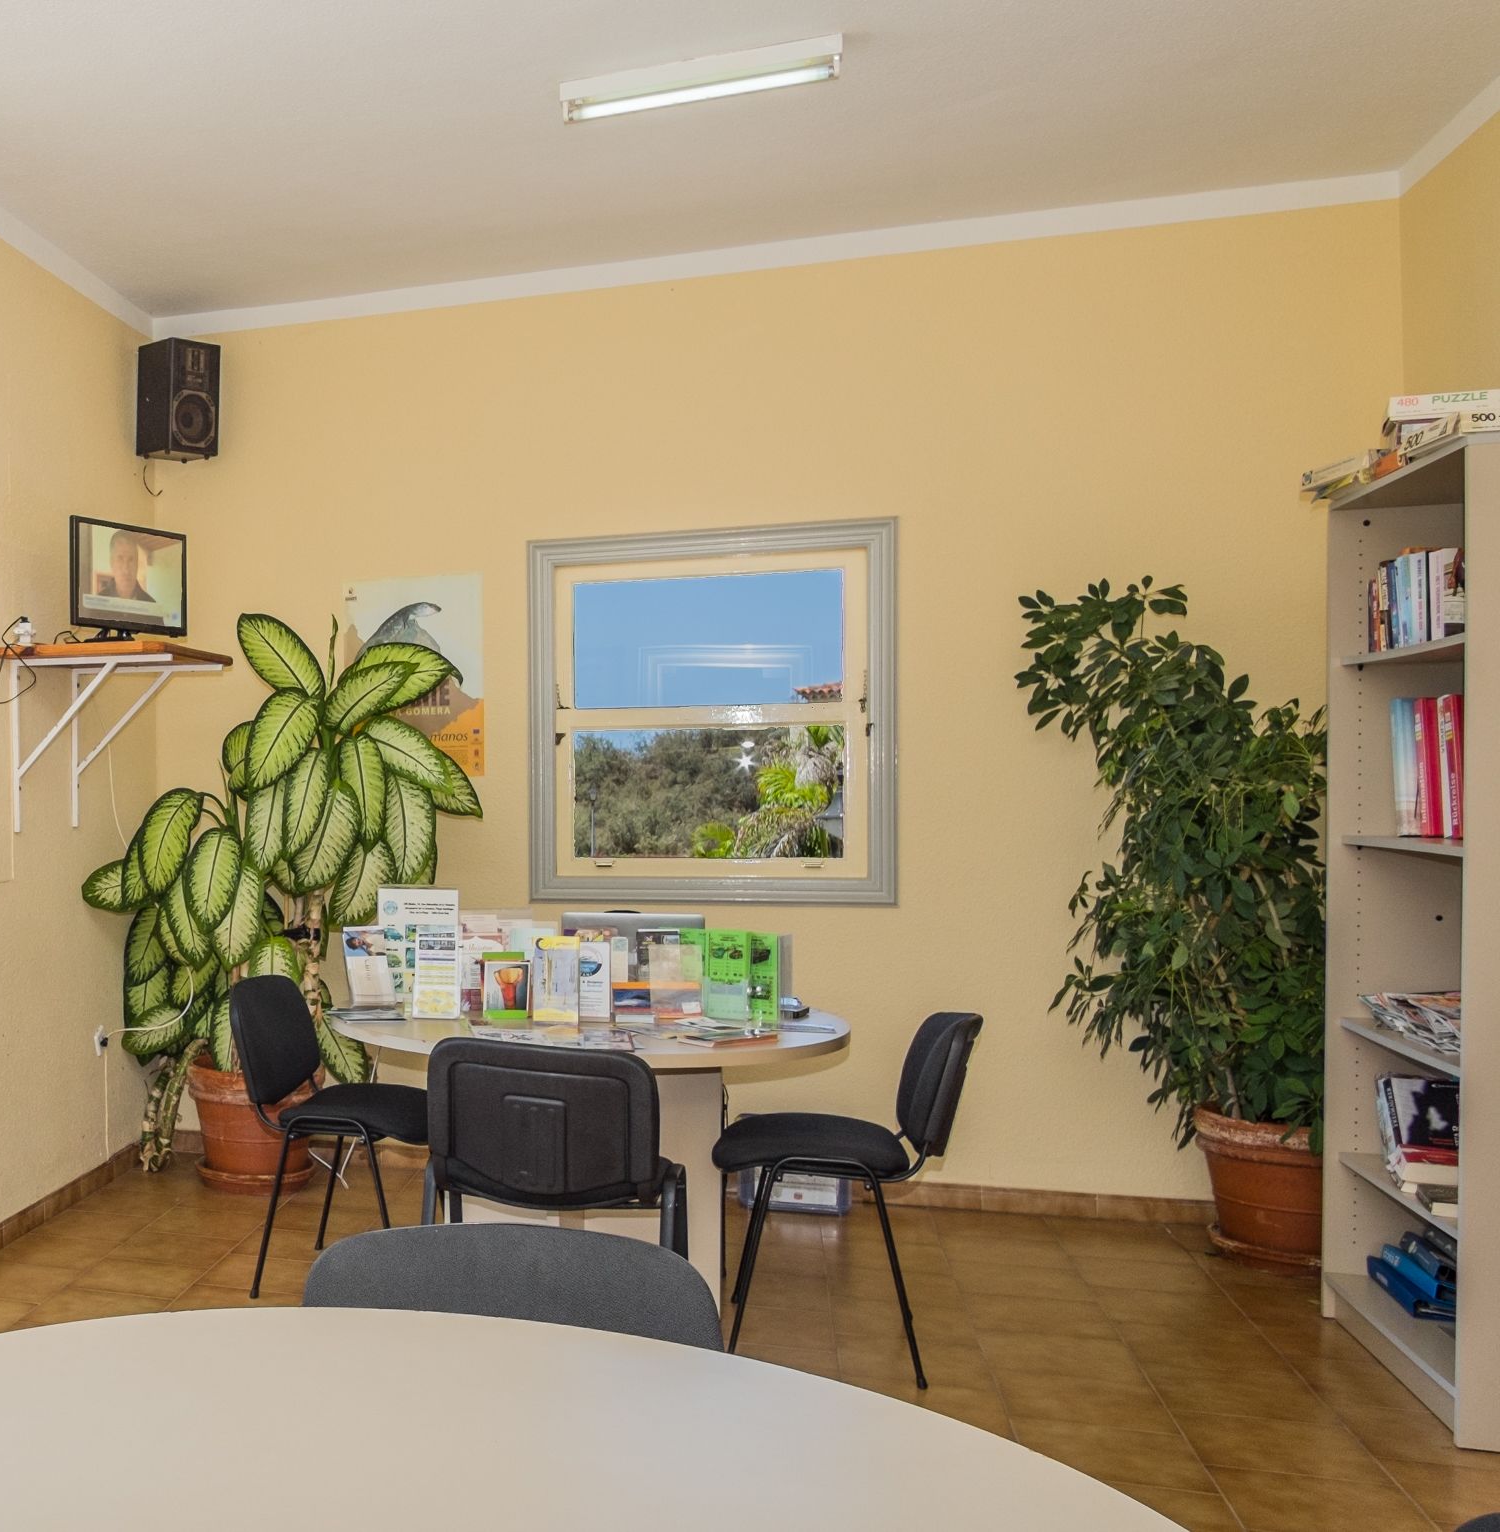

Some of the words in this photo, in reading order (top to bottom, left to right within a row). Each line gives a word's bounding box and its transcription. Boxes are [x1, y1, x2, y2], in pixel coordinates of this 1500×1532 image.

[1396, 396, 1419, 407] 480
[1431, 391, 1489, 404] PUZZLE
[1471, 412, 1496, 423] 500
[1404, 430, 1424, 451] 500
[405, 706, 451, 716] GOMERA
[1450, 772, 1459, 826] Rückreise
